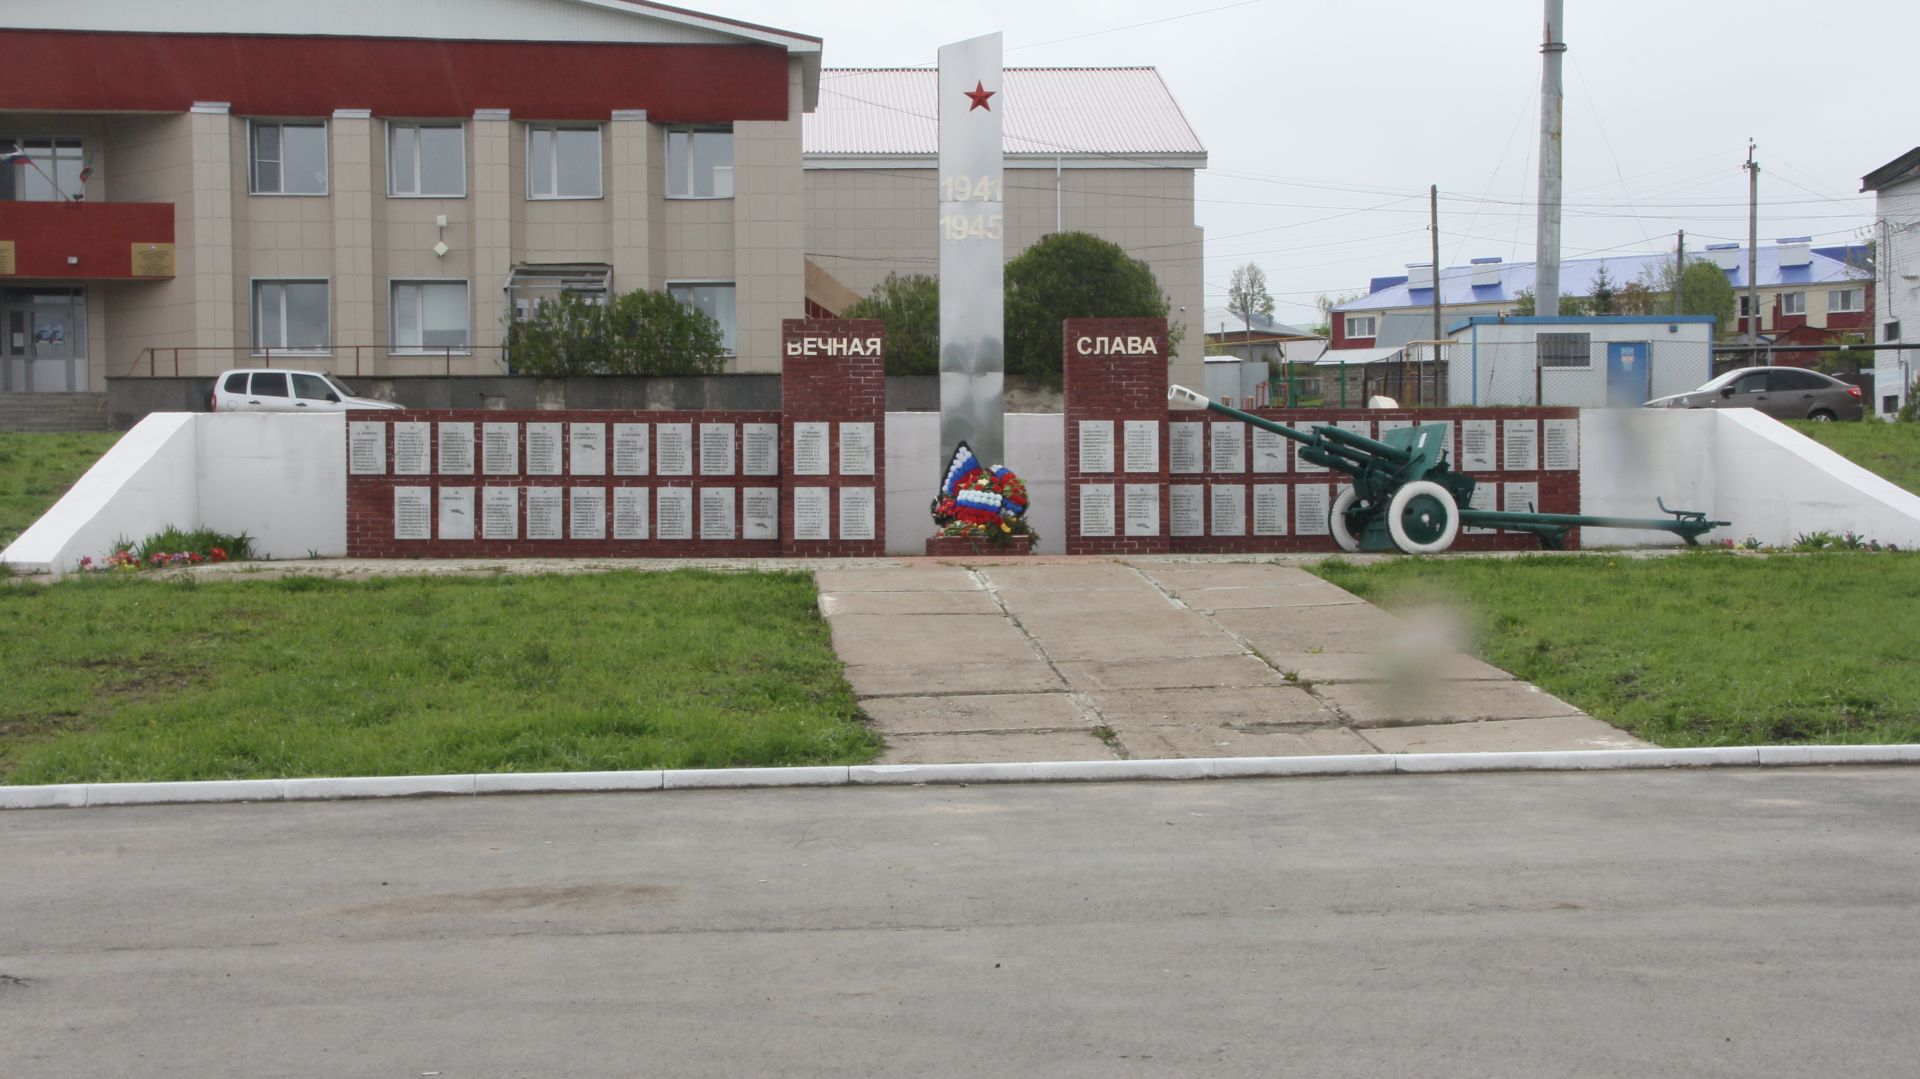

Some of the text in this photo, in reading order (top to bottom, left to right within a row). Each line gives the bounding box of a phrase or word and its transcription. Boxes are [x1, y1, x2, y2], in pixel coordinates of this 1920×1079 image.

[940, 175, 1003, 202] 1941
[940, 213, 1003, 240] 1945
[1076, 336, 1158, 355] СЛАВА
